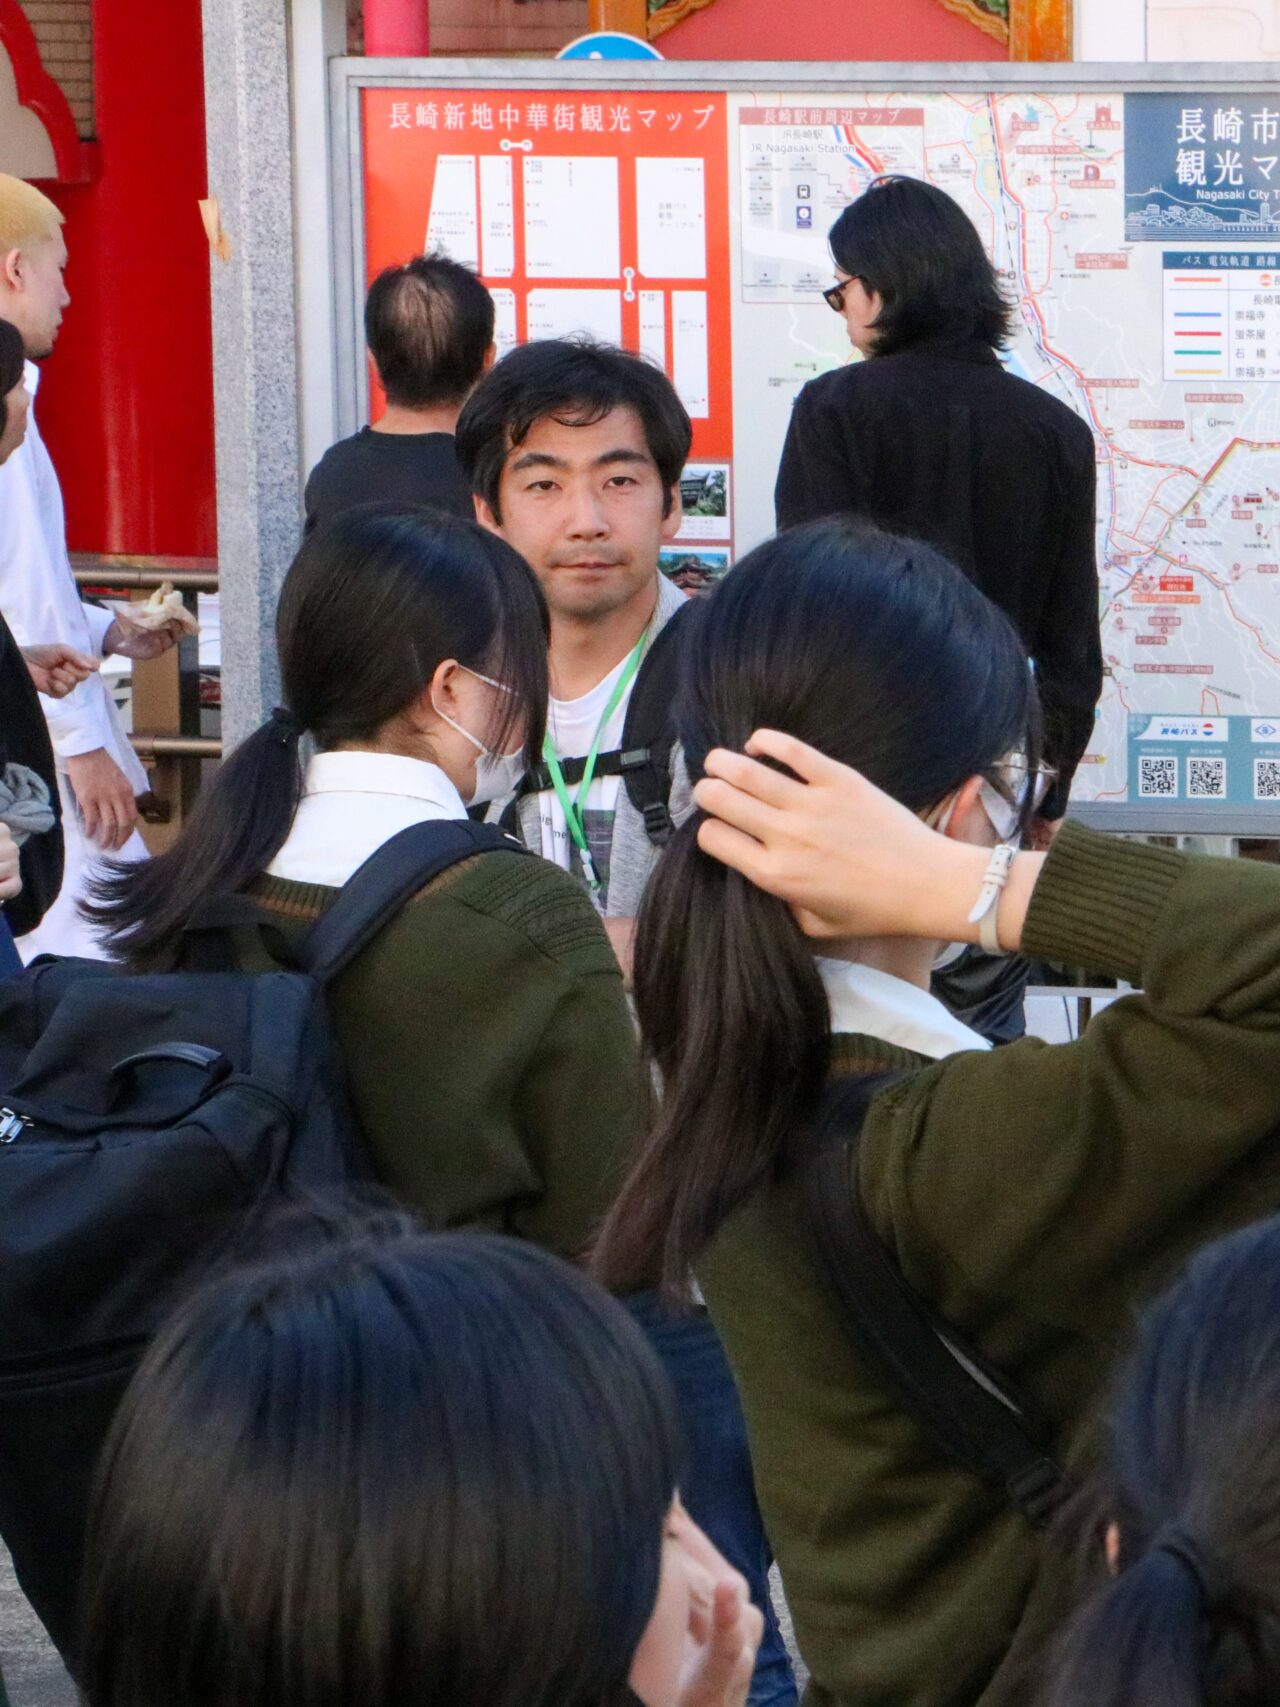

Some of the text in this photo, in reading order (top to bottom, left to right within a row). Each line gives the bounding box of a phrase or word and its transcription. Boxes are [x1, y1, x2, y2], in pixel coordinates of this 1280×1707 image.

[389, 101, 716, 132] 長崎新地中華街観光マップ
[763, 108, 900, 125] 長崎駅前周辺マップ
[766, 143, 814, 156] Nagasaki
[817, 143, 856, 154] Station
[1196, 189, 1245, 202] Nagasaki
[1248, 189, 1270, 202] City
[1182, 255, 1202, 266] バス
[1160, 727, 1199, 736] 長崎バス
